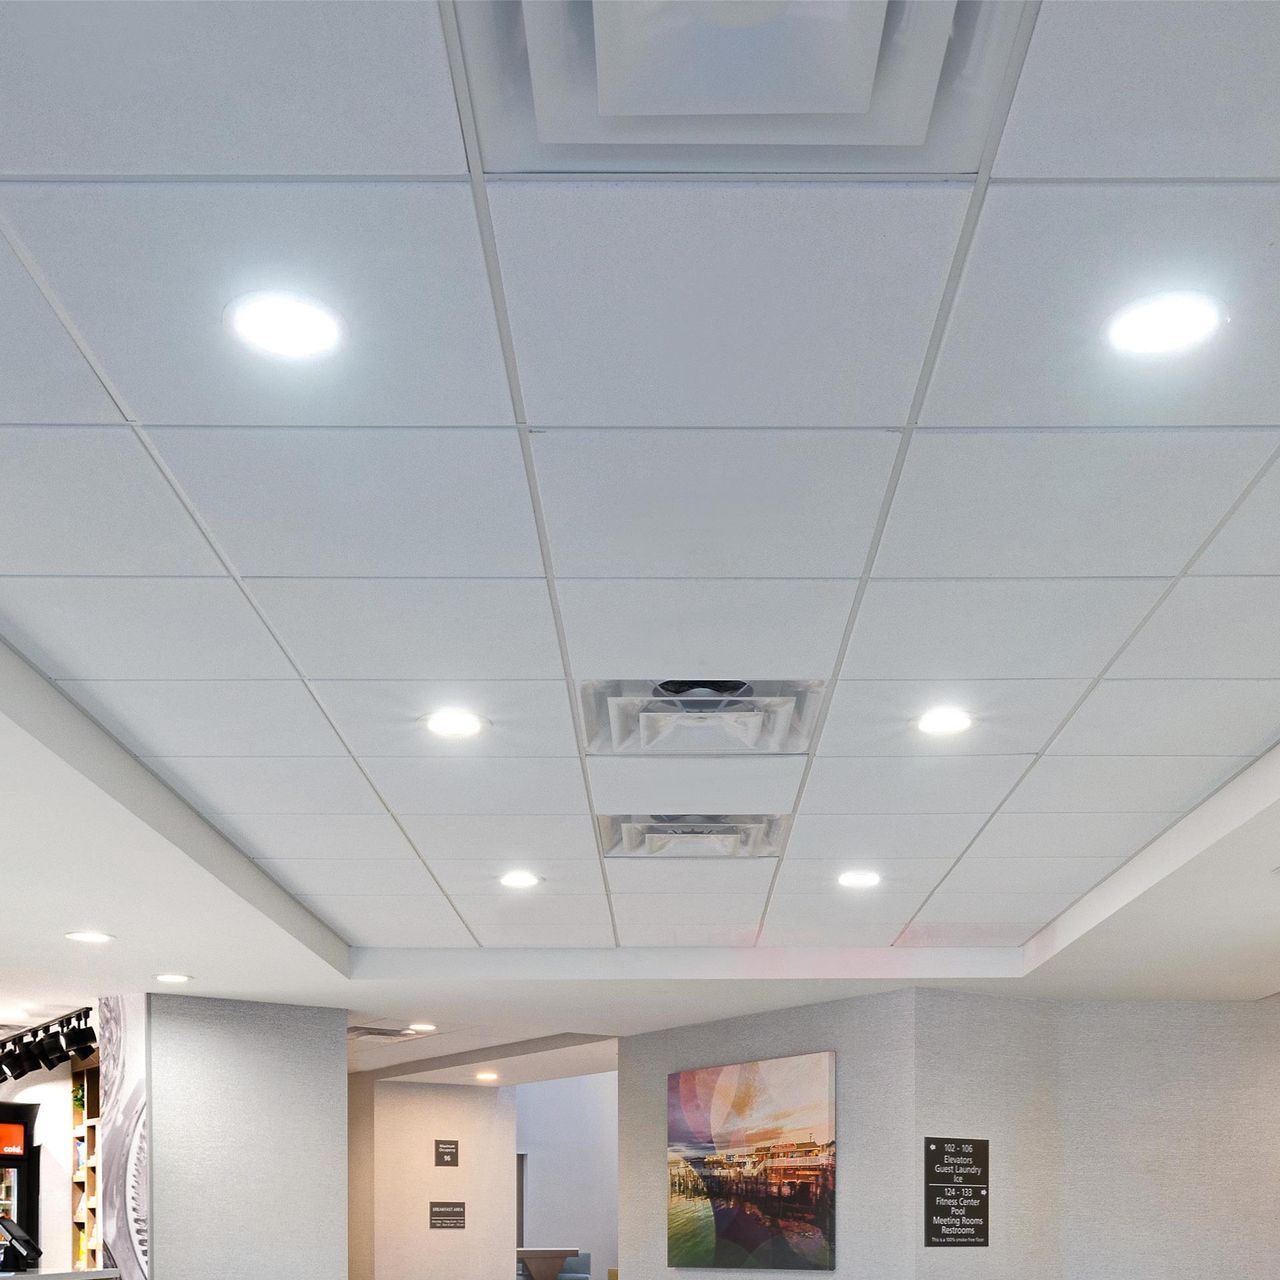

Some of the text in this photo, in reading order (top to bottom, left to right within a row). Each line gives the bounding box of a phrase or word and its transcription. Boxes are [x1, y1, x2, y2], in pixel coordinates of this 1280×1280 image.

[944, 1144, 955, 1153] 102
[961, 1144, 973, 1153] 106
[944, 1155, 973, 1164] Elevators
[934, 1164, 982, 1176] Guest Laundry
[953, 1175, 963, 1183] Ice
[944, 1188, 956, 1196] 124
[936, 1197, 980, 1206] Fitness Center
[950, 1207, 966, 1215] Pool
[932, 1216, 983, 1226] Meeting Rooms
[941, 1226, 975, 1235] Restrooms
